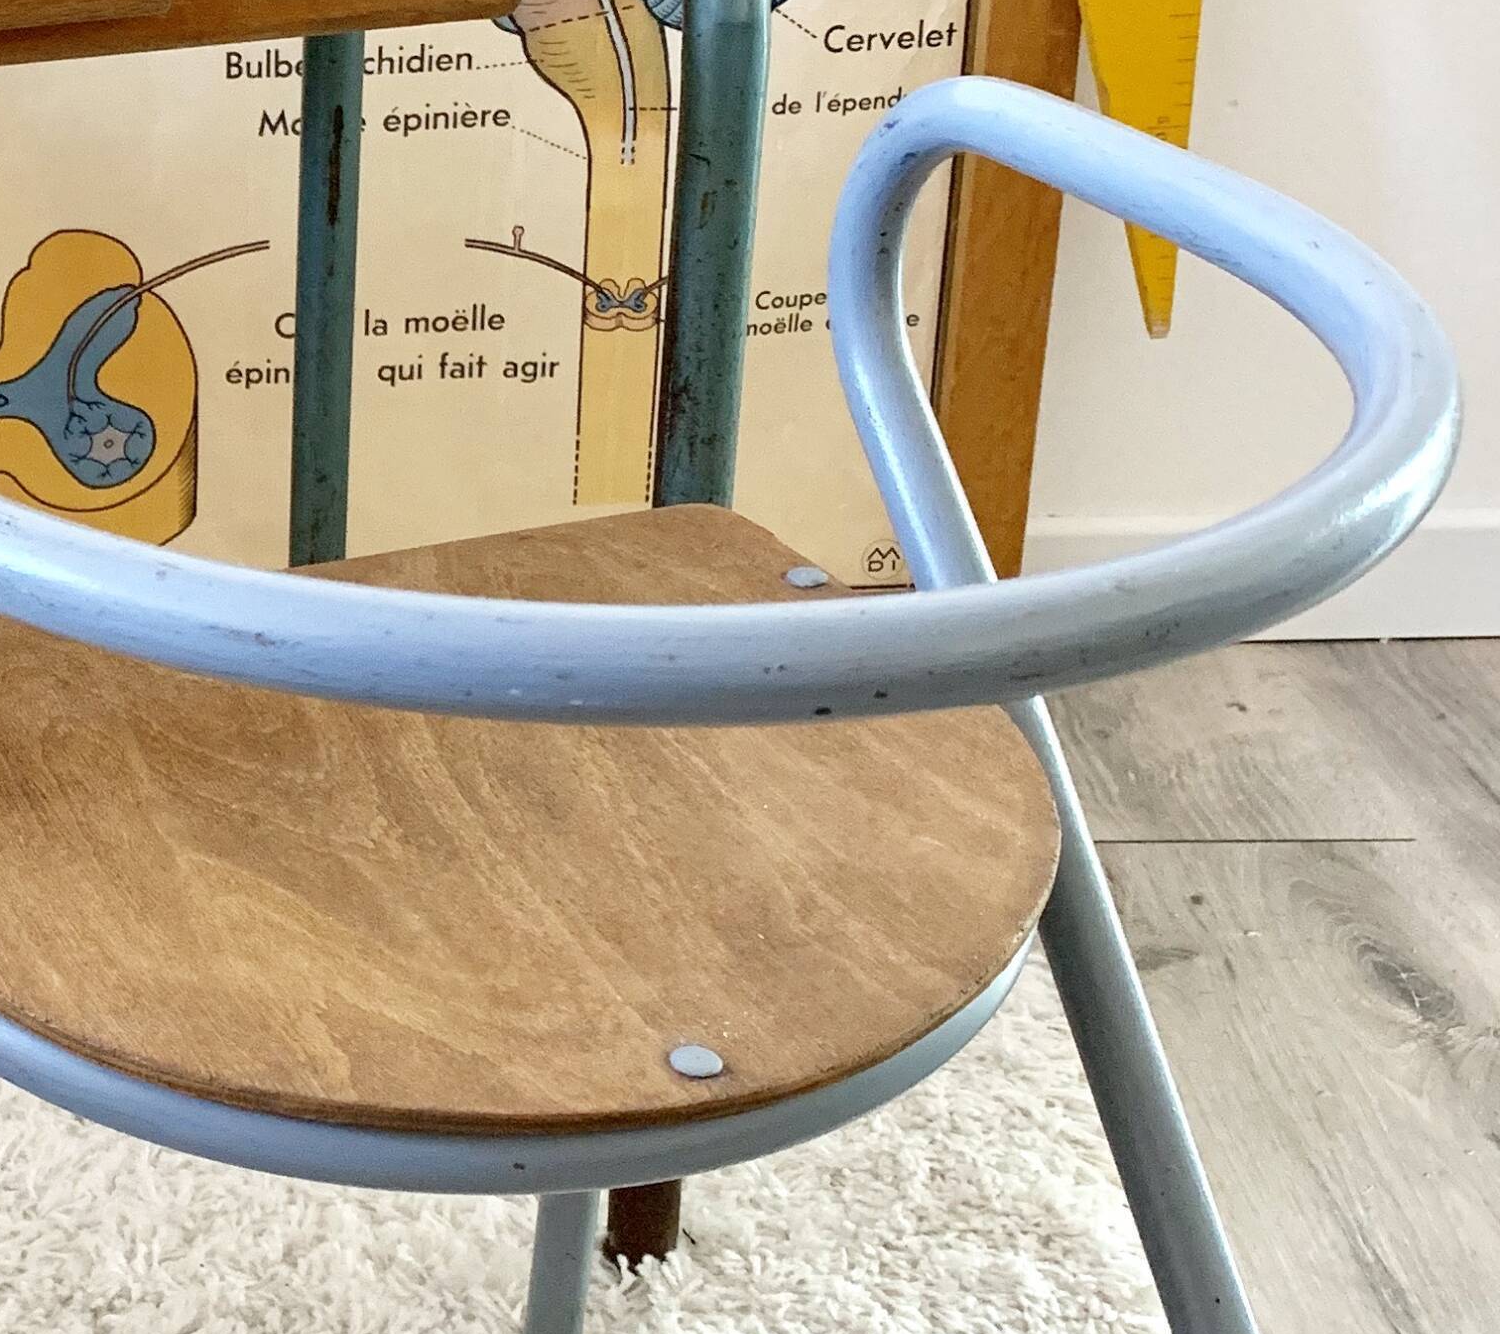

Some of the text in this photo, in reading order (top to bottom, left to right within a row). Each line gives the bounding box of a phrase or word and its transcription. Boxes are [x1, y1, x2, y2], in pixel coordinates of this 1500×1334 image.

[823, 18, 959, 54] Cervelet
[363, 43, 474, 76] chidien
[382, 101, 512, 137] épinière
[771, 92, 803, 116] de
[363, 302, 506, 337] la moëlle
[754, 289, 828, 316] Coupe
[376, 354, 424, 387] qui
[439, 351, 488, 380] fait
[501, 352, 560, 384] agir
